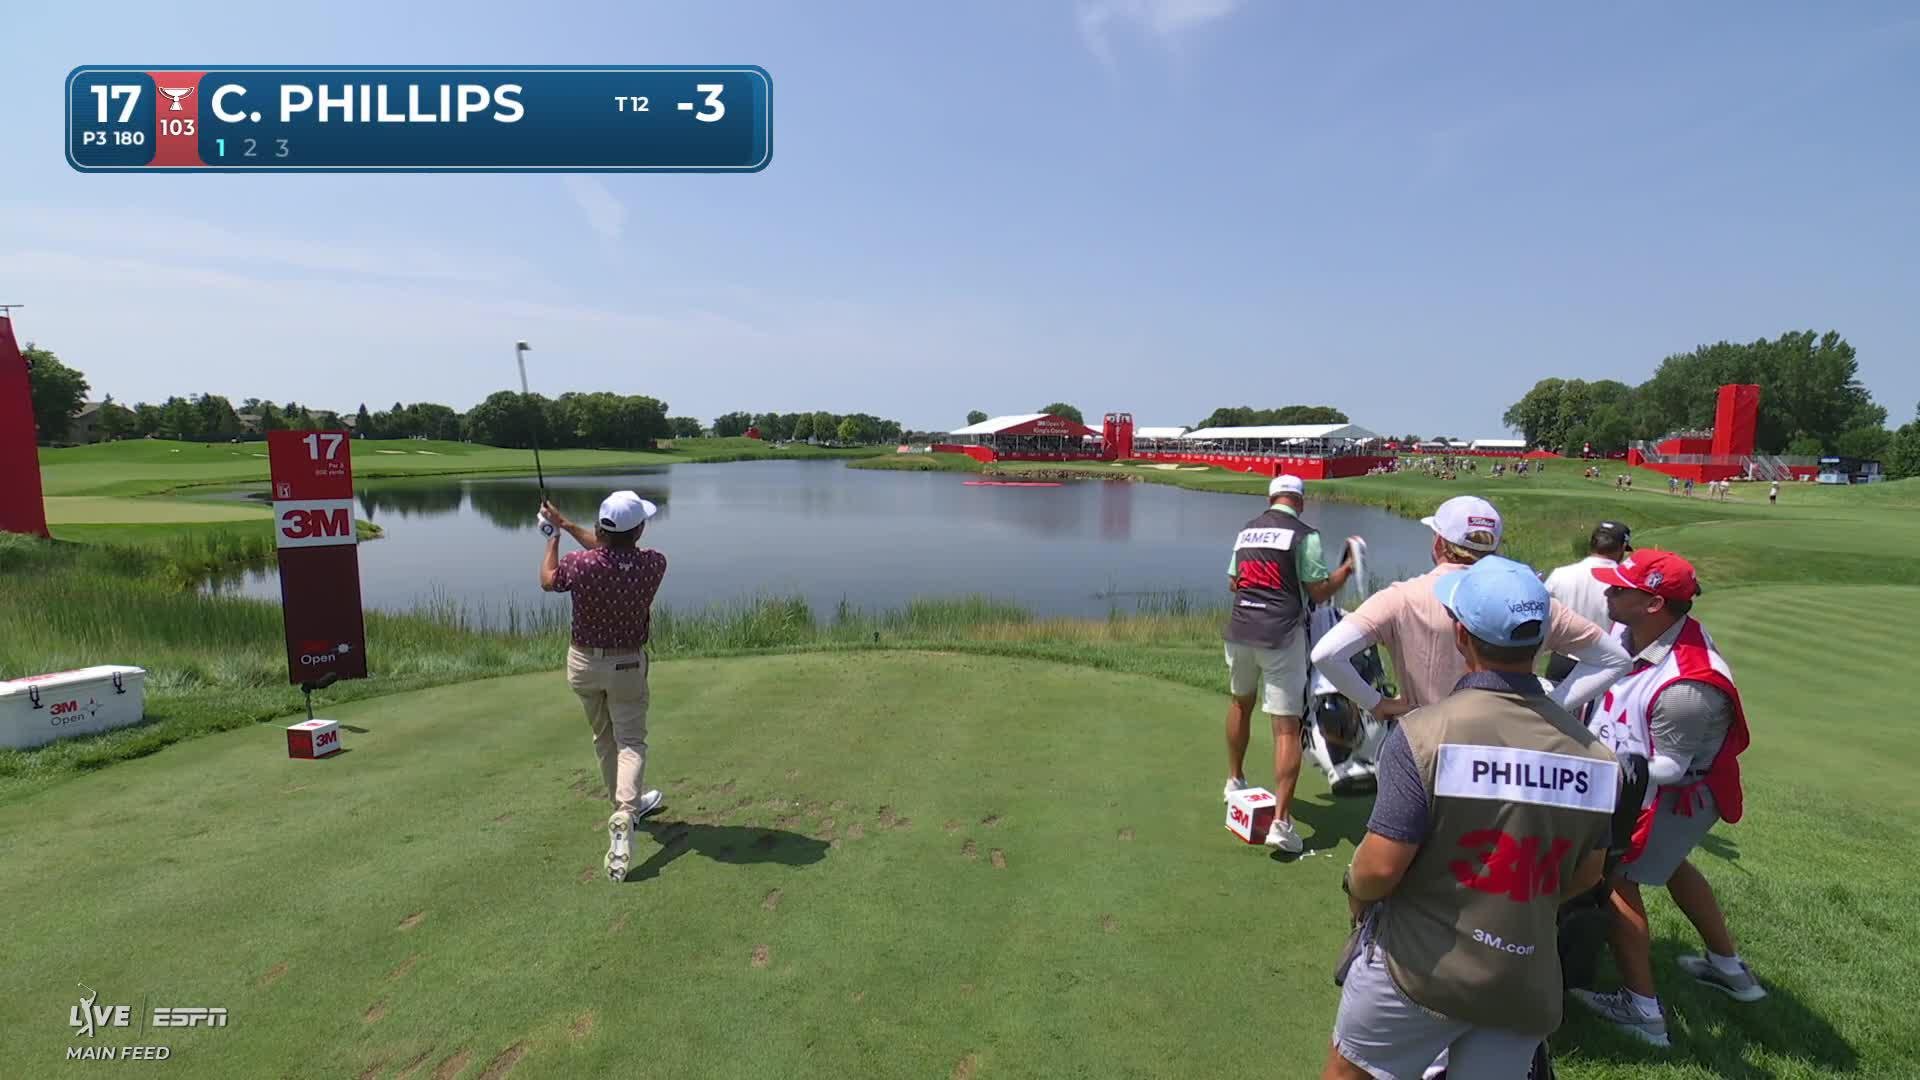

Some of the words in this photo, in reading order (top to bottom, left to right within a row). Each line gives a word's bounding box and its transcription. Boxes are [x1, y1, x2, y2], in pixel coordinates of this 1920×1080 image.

[303, 433, 343, 460] 17
[281, 508, 350, 539] 3M
[300, 653, 336, 666] Open
[49, 700, 78, 716] 3M
[50, 713, 85, 728] Open
[316, 730, 337, 747] 3M
[1472, 760, 1589, 794] PHILLIPS
[1230, 805, 1250, 829] 3M
[1448, 828, 1574, 904] 3M
